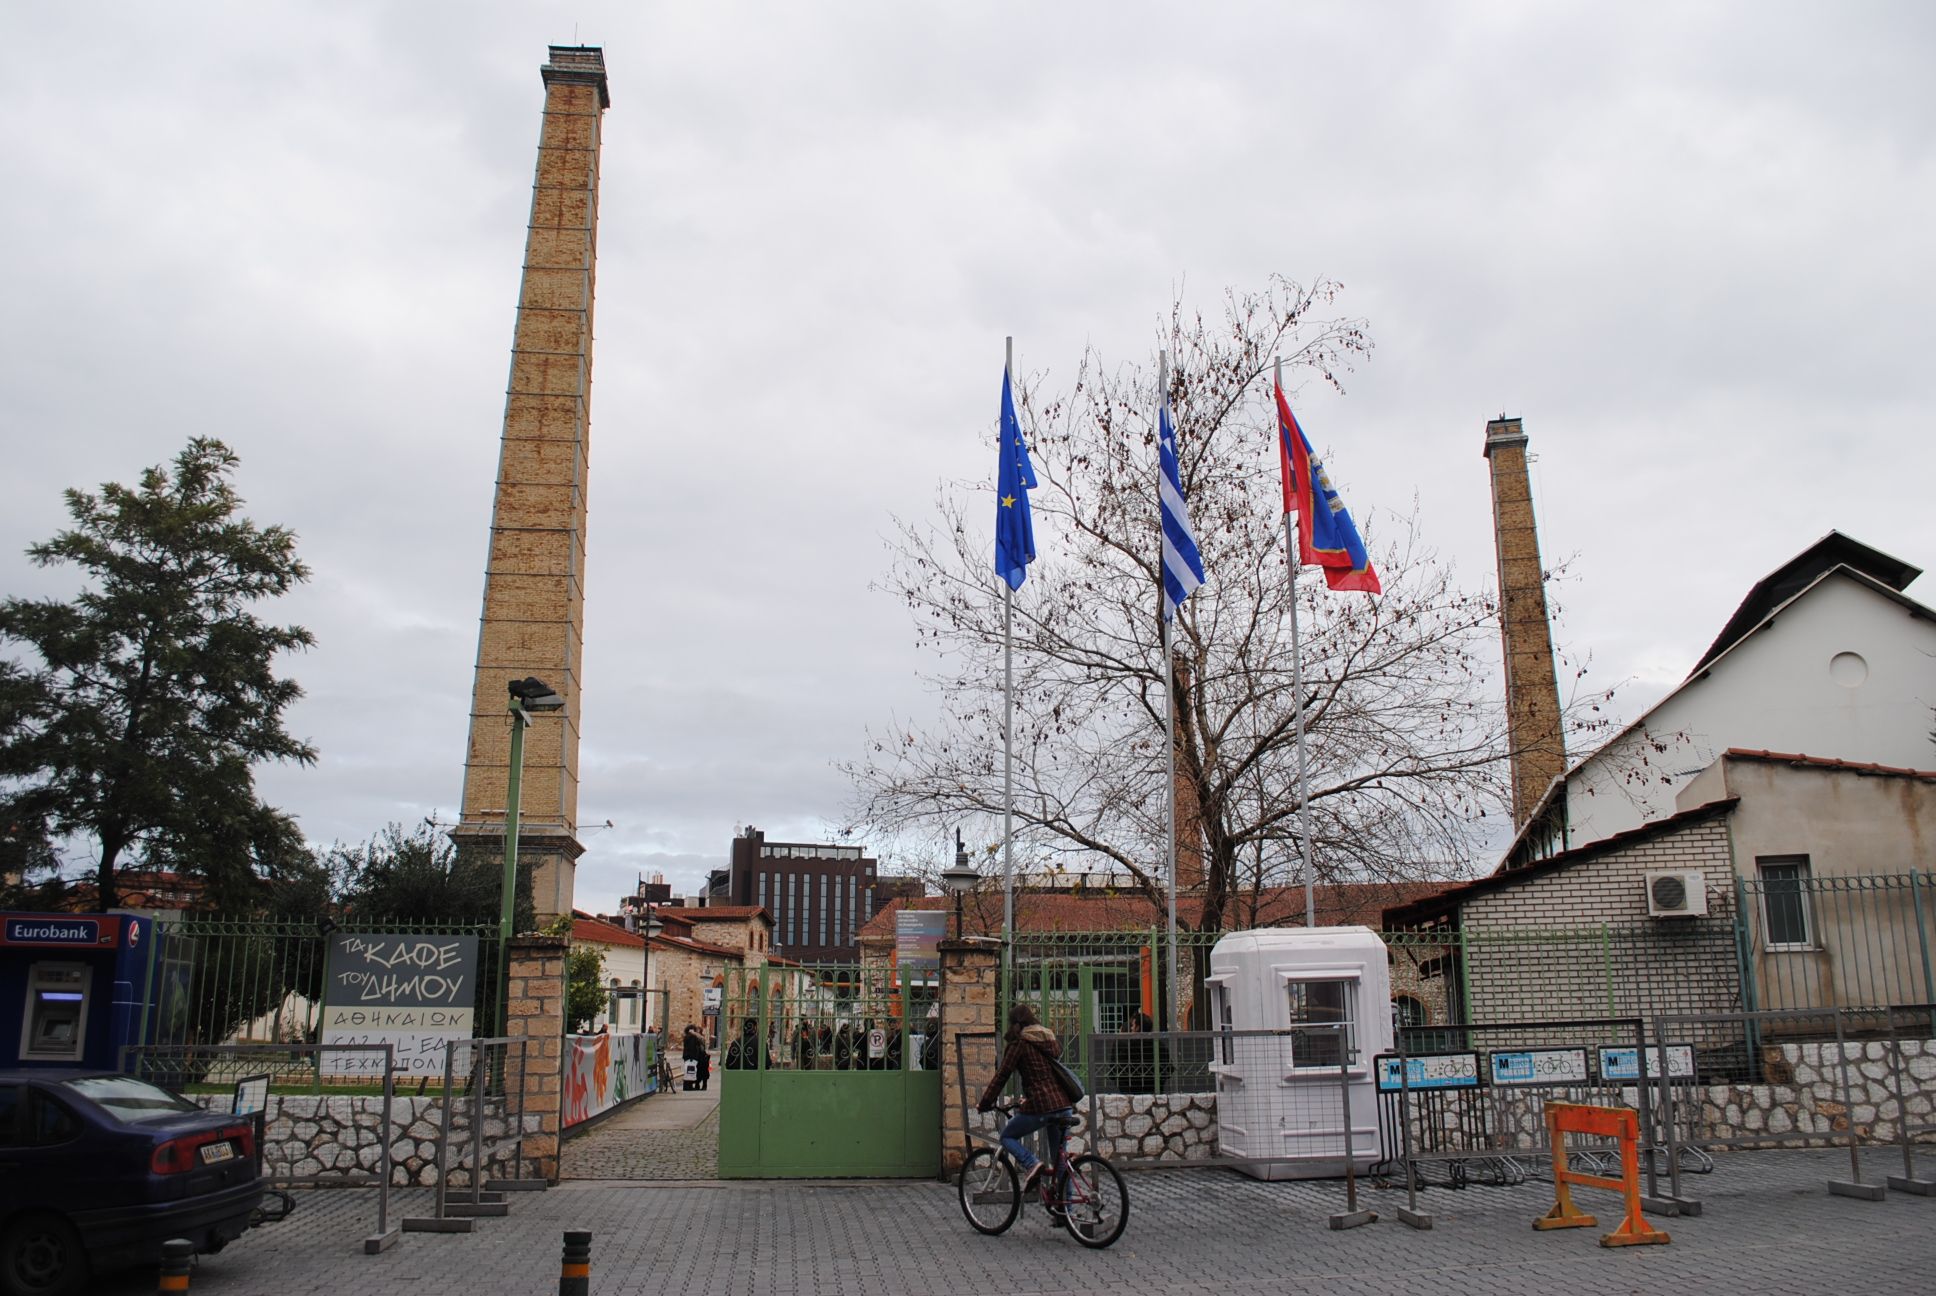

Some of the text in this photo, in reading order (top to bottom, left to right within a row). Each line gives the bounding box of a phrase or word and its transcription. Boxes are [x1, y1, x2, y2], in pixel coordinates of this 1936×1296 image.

[14, 924, 89, 939] Eurobank
[340, 937, 462, 970] ΤΑ ΚΑΦΕ
[338, 972, 464, 1003] ΤΟΥ ΔΗΜΟΥ
[334, 1011, 465, 1027] ΑΘΗΝΑΙΩΝ
